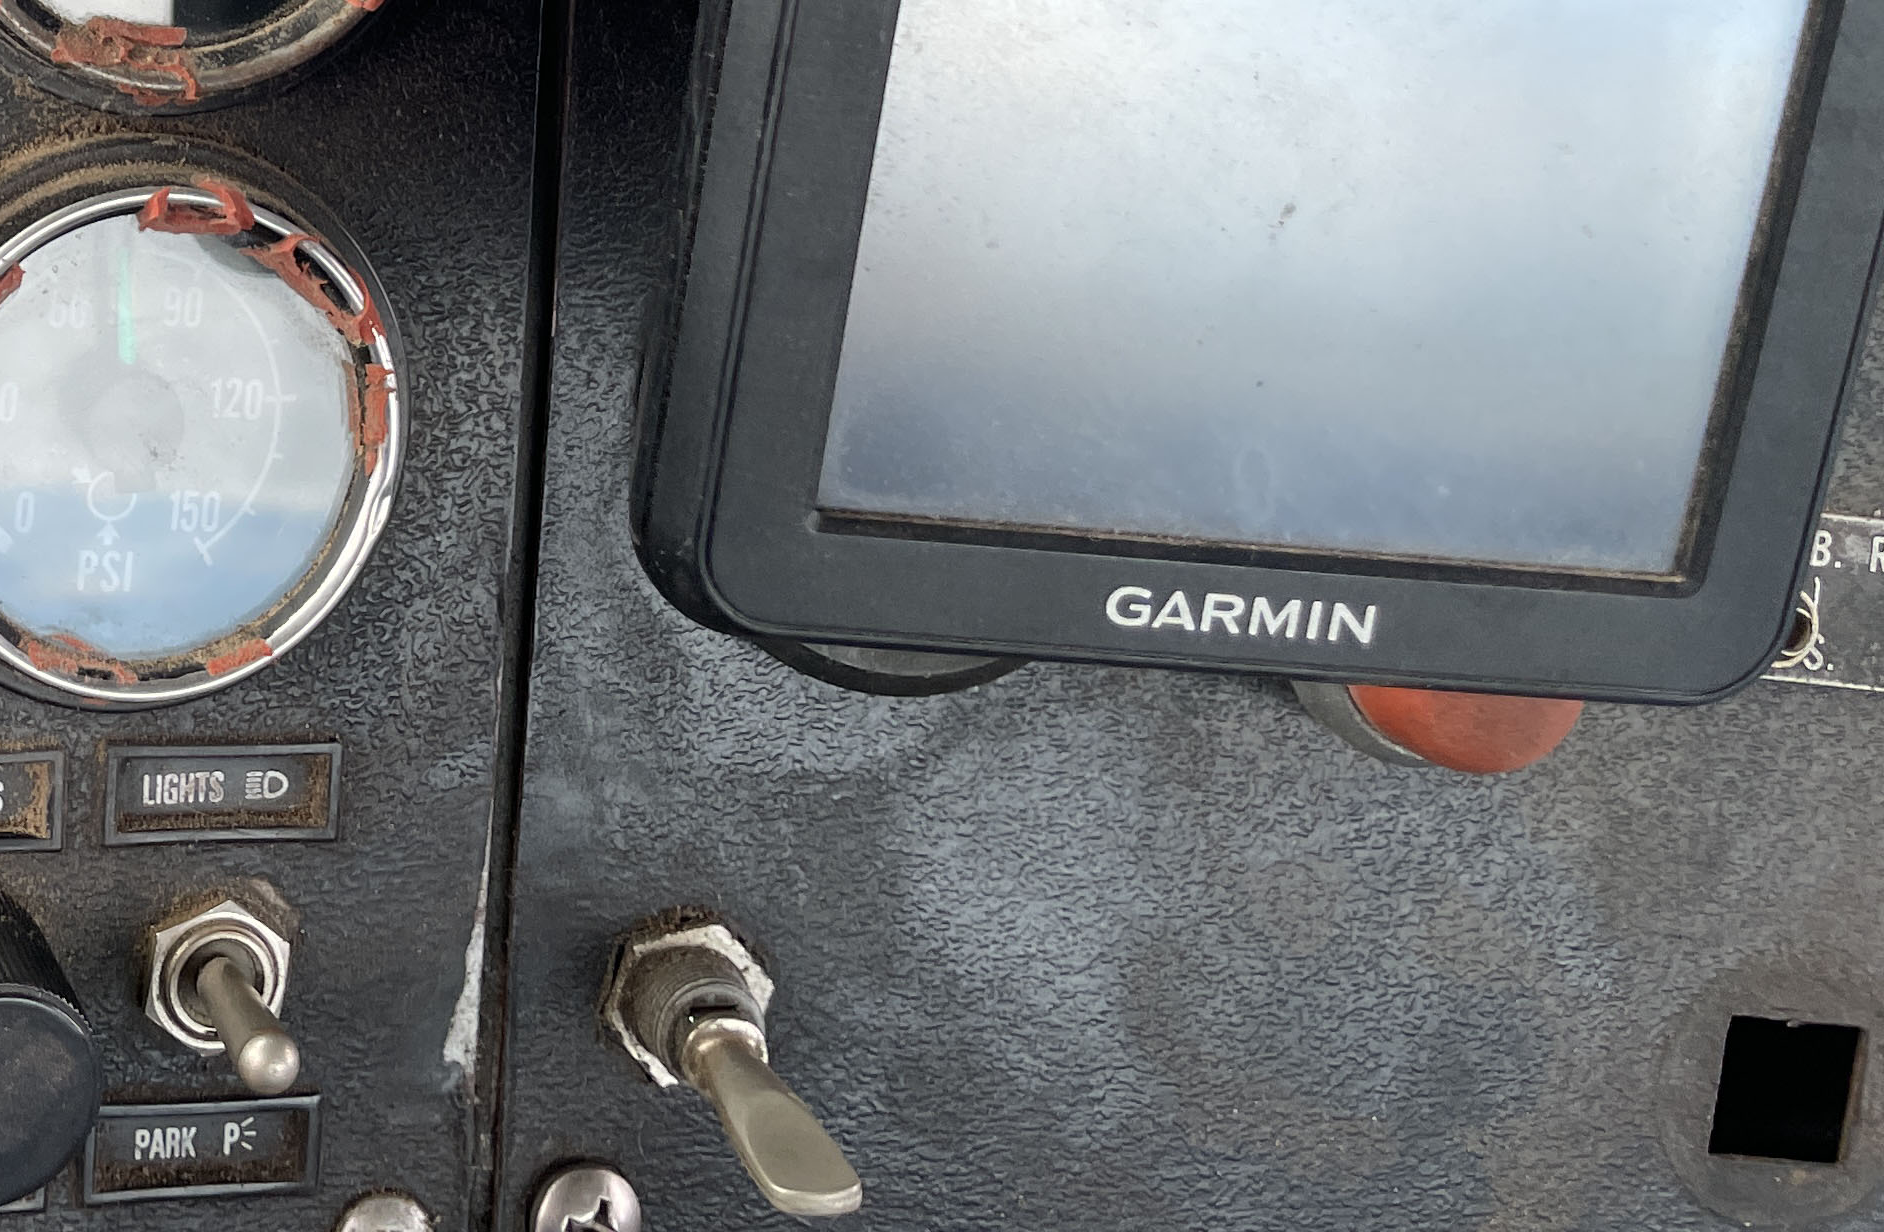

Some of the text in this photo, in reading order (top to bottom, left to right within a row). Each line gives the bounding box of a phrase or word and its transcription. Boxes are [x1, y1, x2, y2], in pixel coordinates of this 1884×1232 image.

[163, 289, 203, 328] 90
[211, 378, 264, 419] 120
[170, 491, 220, 531] 150
[77, 552, 133, 591] PSI
[1105, 585, 1378, 645] GARMIN
[142, 770, 226, 806] LIGHTS
[134, 1127, 197, 1161] PARK
